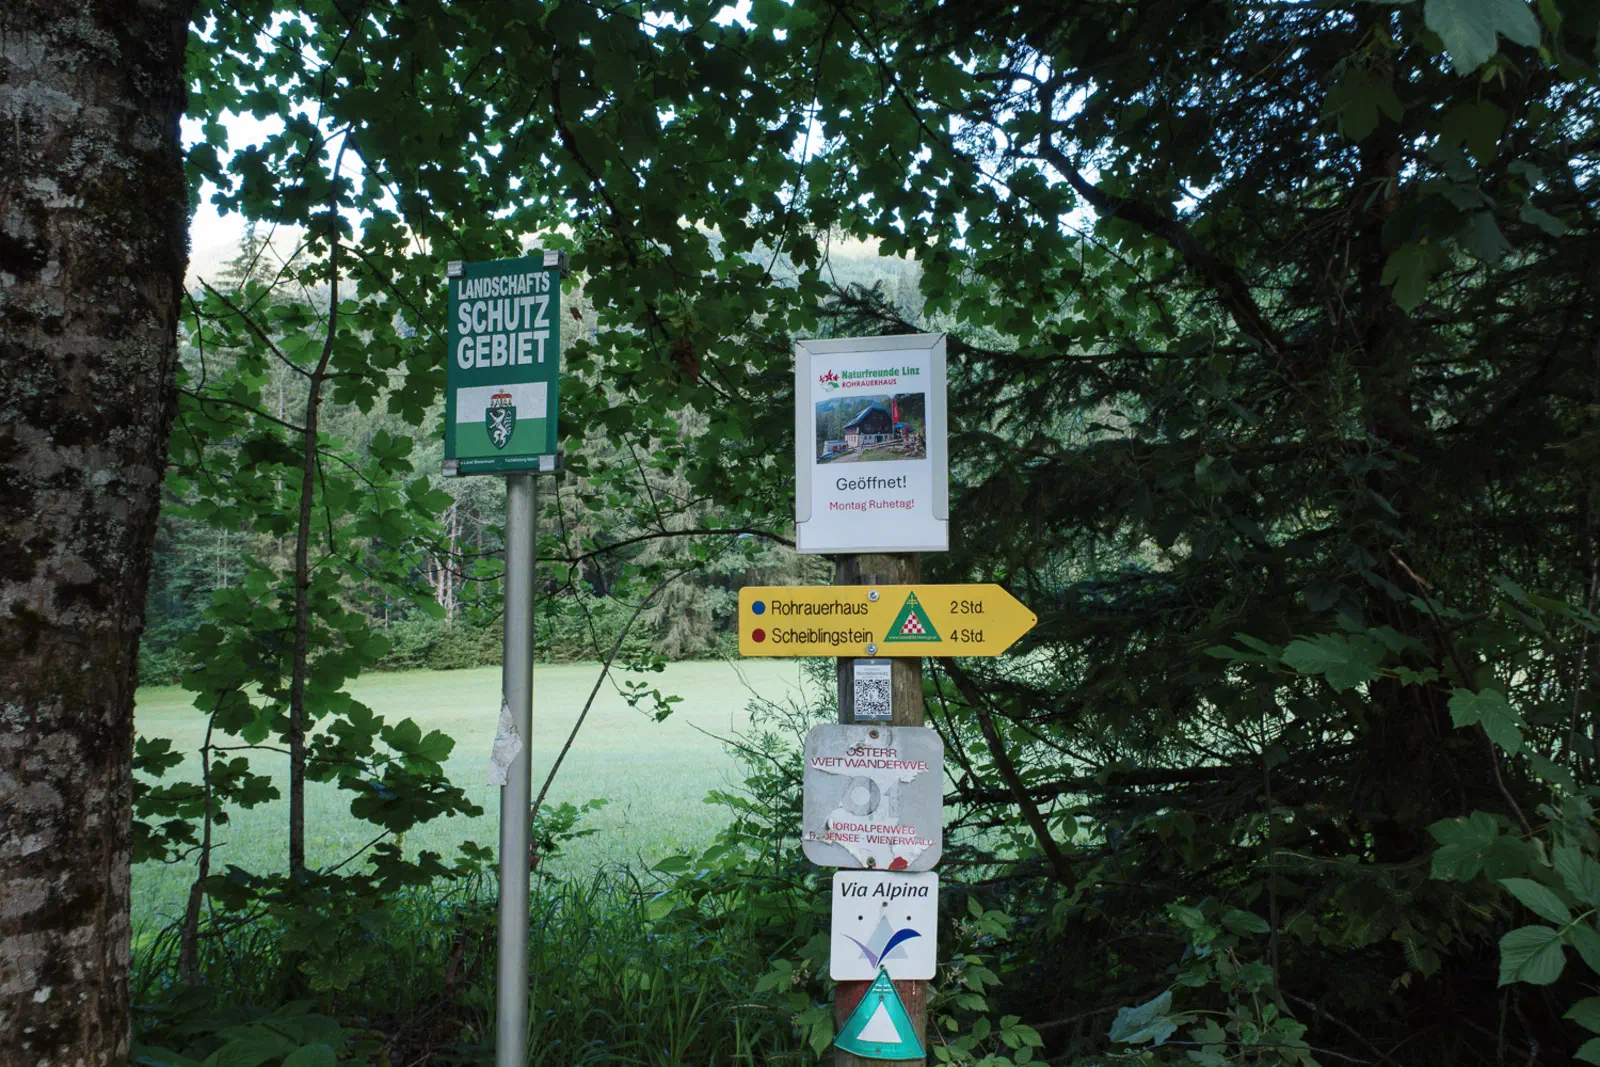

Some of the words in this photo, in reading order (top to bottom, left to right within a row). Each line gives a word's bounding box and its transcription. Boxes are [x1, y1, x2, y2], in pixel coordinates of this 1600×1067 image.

[457, 271, 550, 300] LANDSCHAFTS
[457, 294, 550, 335] SCHUTZ
[457, 330, 550, 370] GEBIET
[841, 367, 900, 380] Naturfreunde
[902, 366, 920, 376] Linz
[841, 378, 897, 388] ROHRAUERHAUS
[836, 475, 907, 491] Geöffnet!
[829, 501, 867, 512] Montag
[868, 498, 915, 510] Ruhetag!
[771, 600, 869, 616] Rohrauerhaus
[950, 600, 959, 614] 2
[960, 600, 985, 614] Std.
[771, 627, 874, 647] Scheiblingstein
[950, 629, 959, 643] 4
[960, 629, 985, 643] Std.
[809, 831, 860, 843] BDENSEE
[841, 882, 868, 898] Via
[872, 882, 929, 901] Alpina
